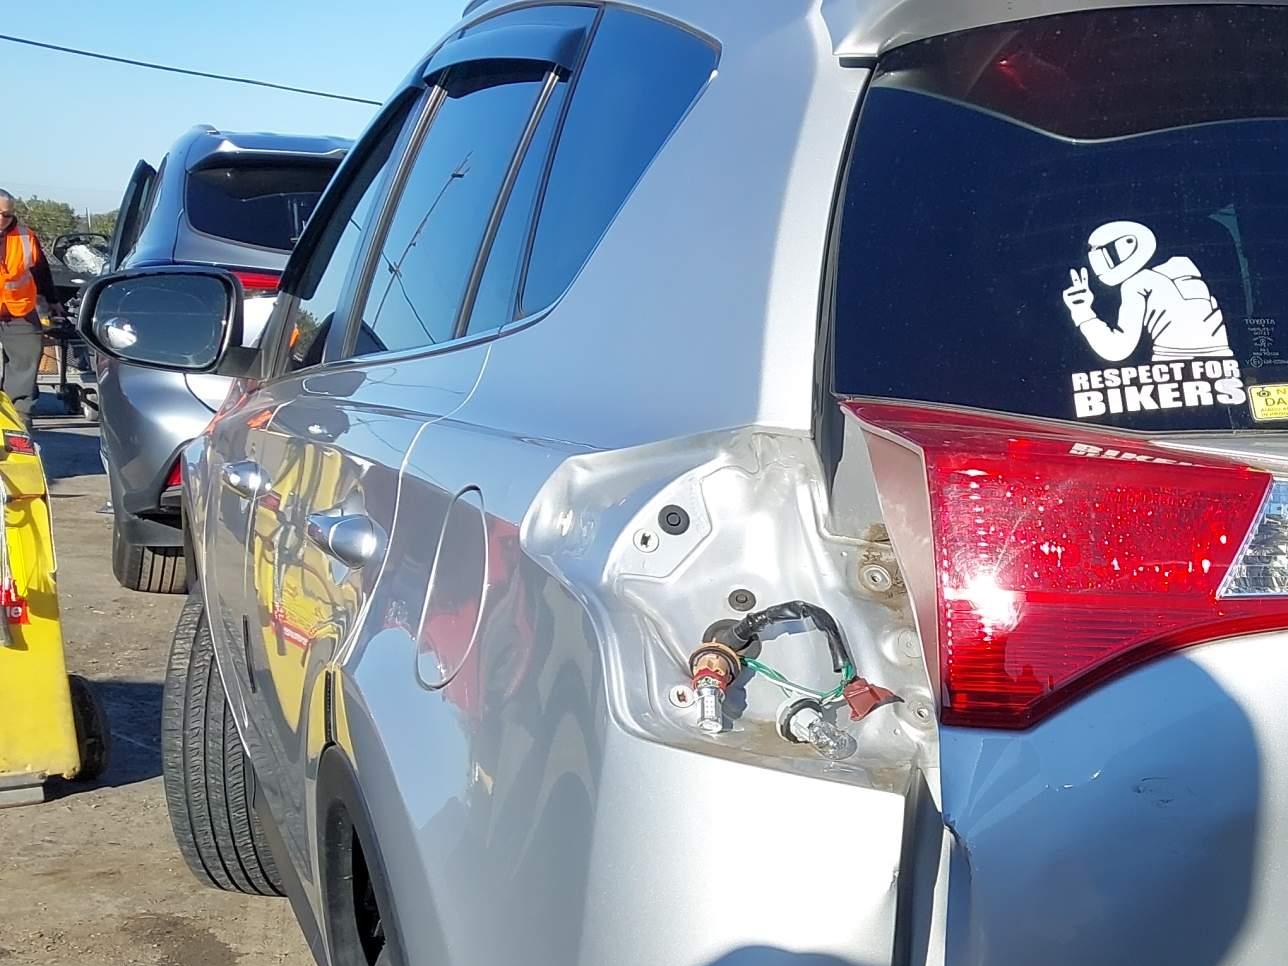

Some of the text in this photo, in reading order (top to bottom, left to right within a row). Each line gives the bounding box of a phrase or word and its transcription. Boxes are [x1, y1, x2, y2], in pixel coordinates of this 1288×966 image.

[1071, 362, 1186, 392] RESPECT
[1191, 359, 1241, 380] FOR
[1073, 377, 1247, 418] BIKERS
